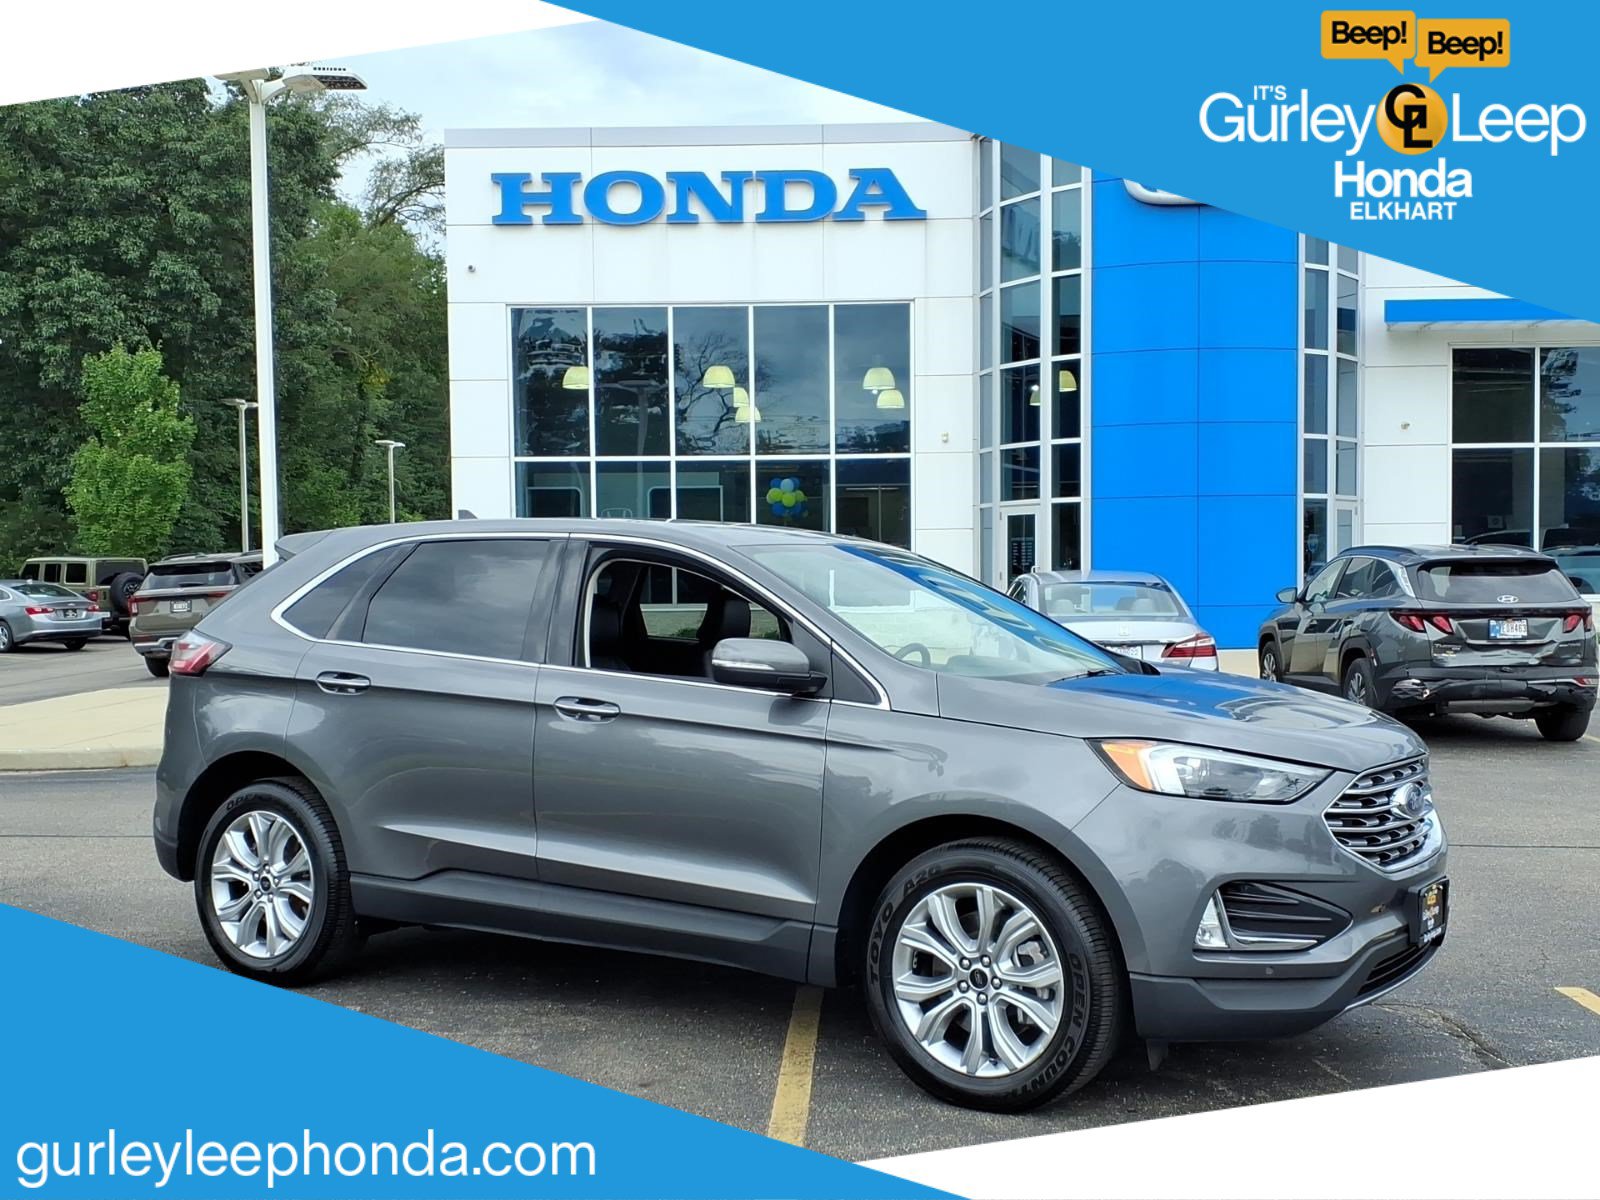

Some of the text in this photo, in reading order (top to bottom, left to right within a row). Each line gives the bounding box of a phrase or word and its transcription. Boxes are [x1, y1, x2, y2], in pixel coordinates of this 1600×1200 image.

[491, 168, 927, 225] HONDA
[870, 902, 894, 985] TOYO
[1068, 953, 1087, 1027] OPEN
